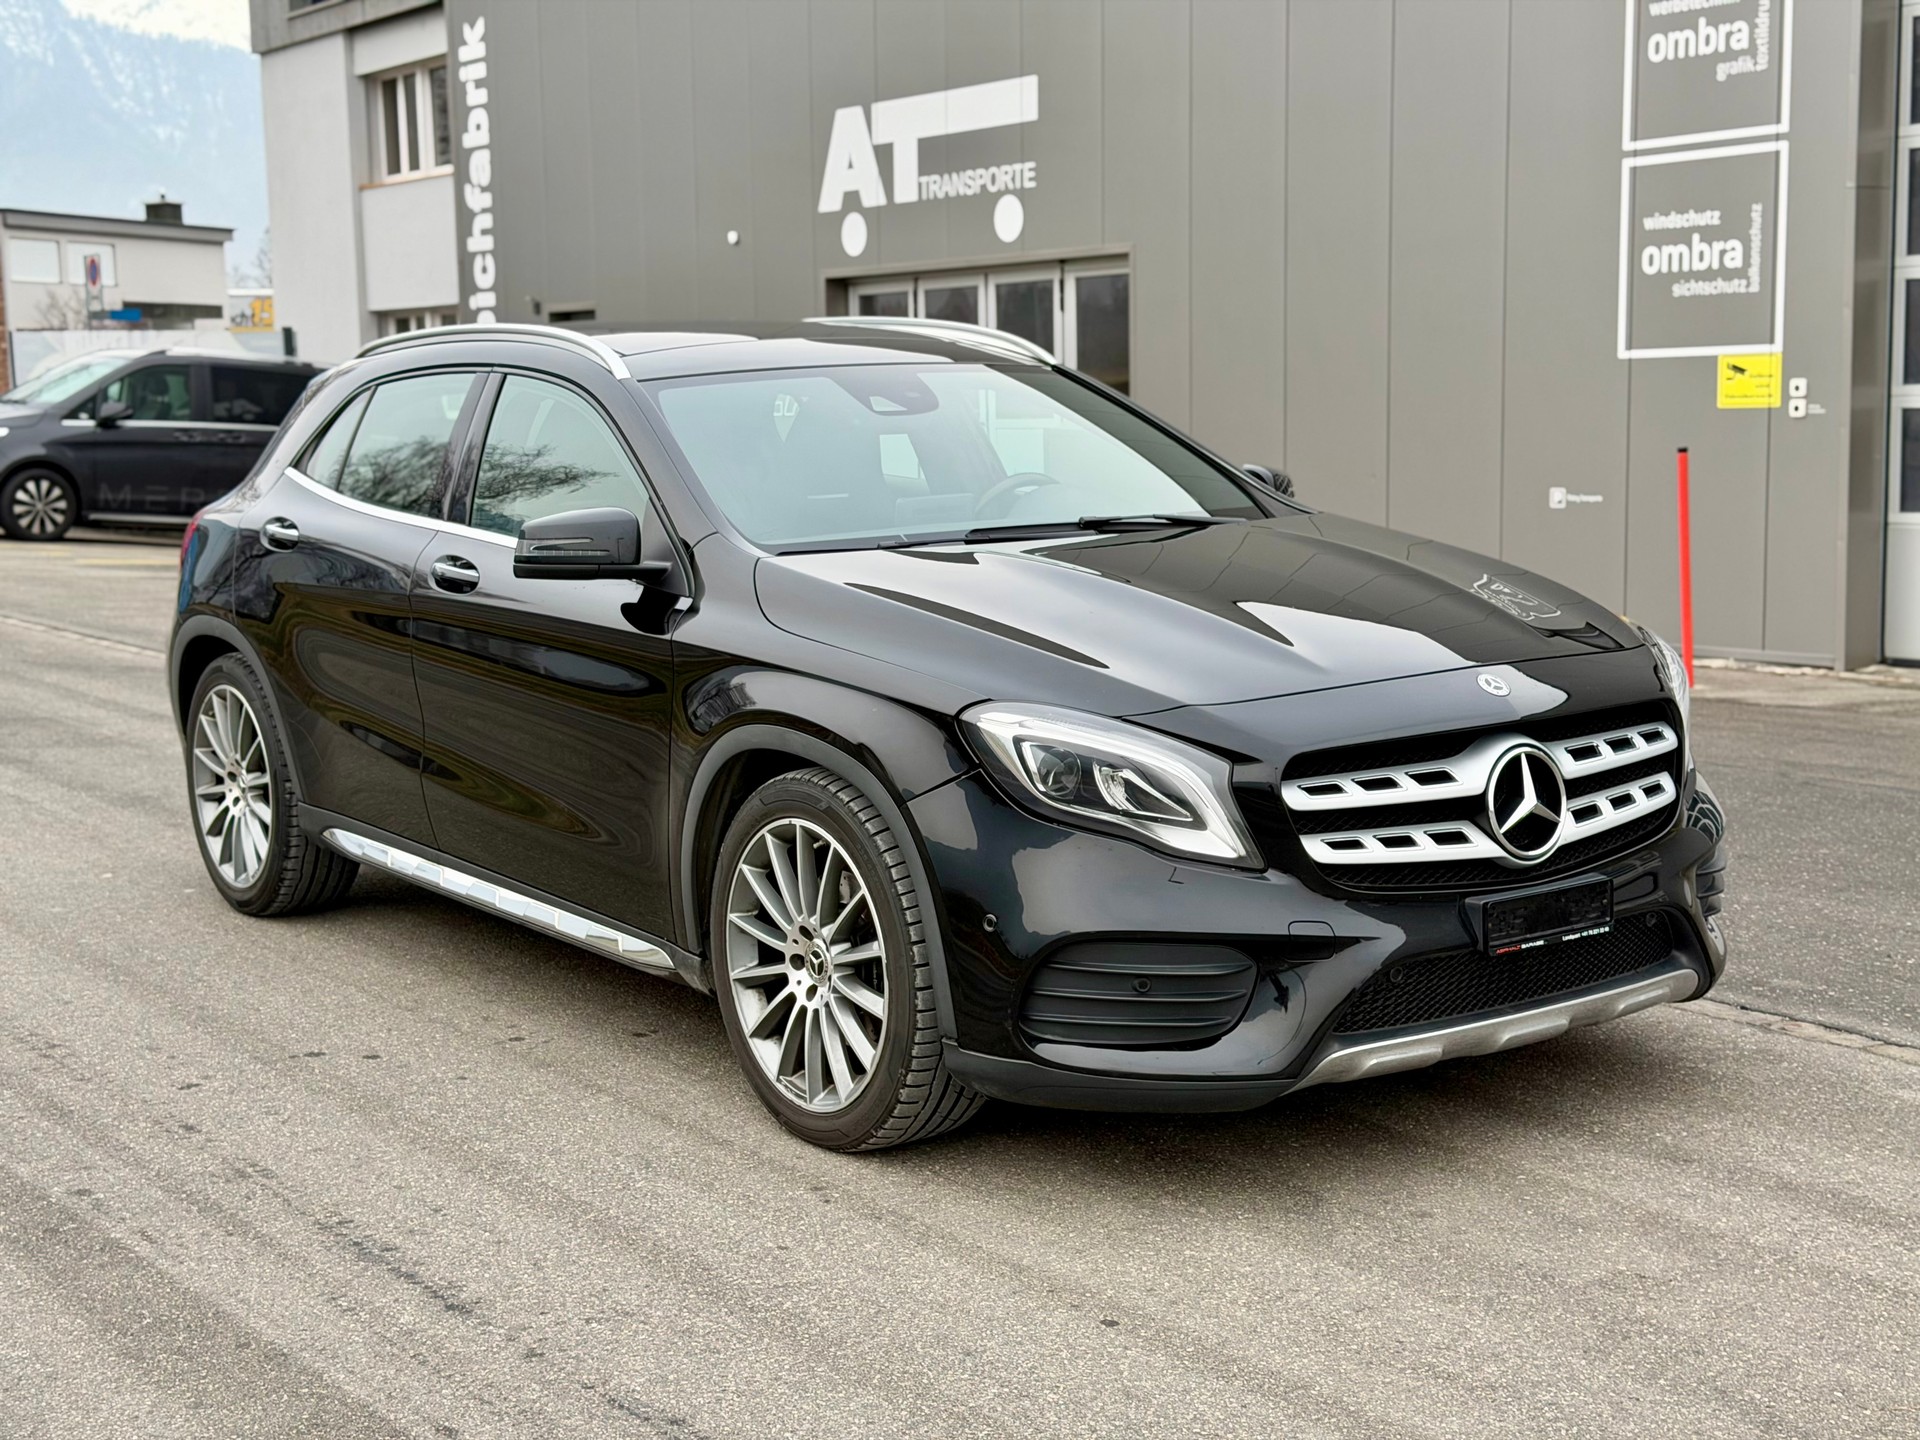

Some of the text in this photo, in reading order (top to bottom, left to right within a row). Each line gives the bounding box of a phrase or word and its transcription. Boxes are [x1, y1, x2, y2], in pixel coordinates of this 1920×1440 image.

[1648, 17, 1749, 63] ombra
[1716, 55, 1755, 81] grafik
[918, 161, 1037, 200] TRANSPORTE
[1643, 208, 1721, 231] windschutz
[1641, 232, 1743, 275] ombra
[1672, 277, 1747, 297] sichtschutz
[100, 482, 226, 512] MER
